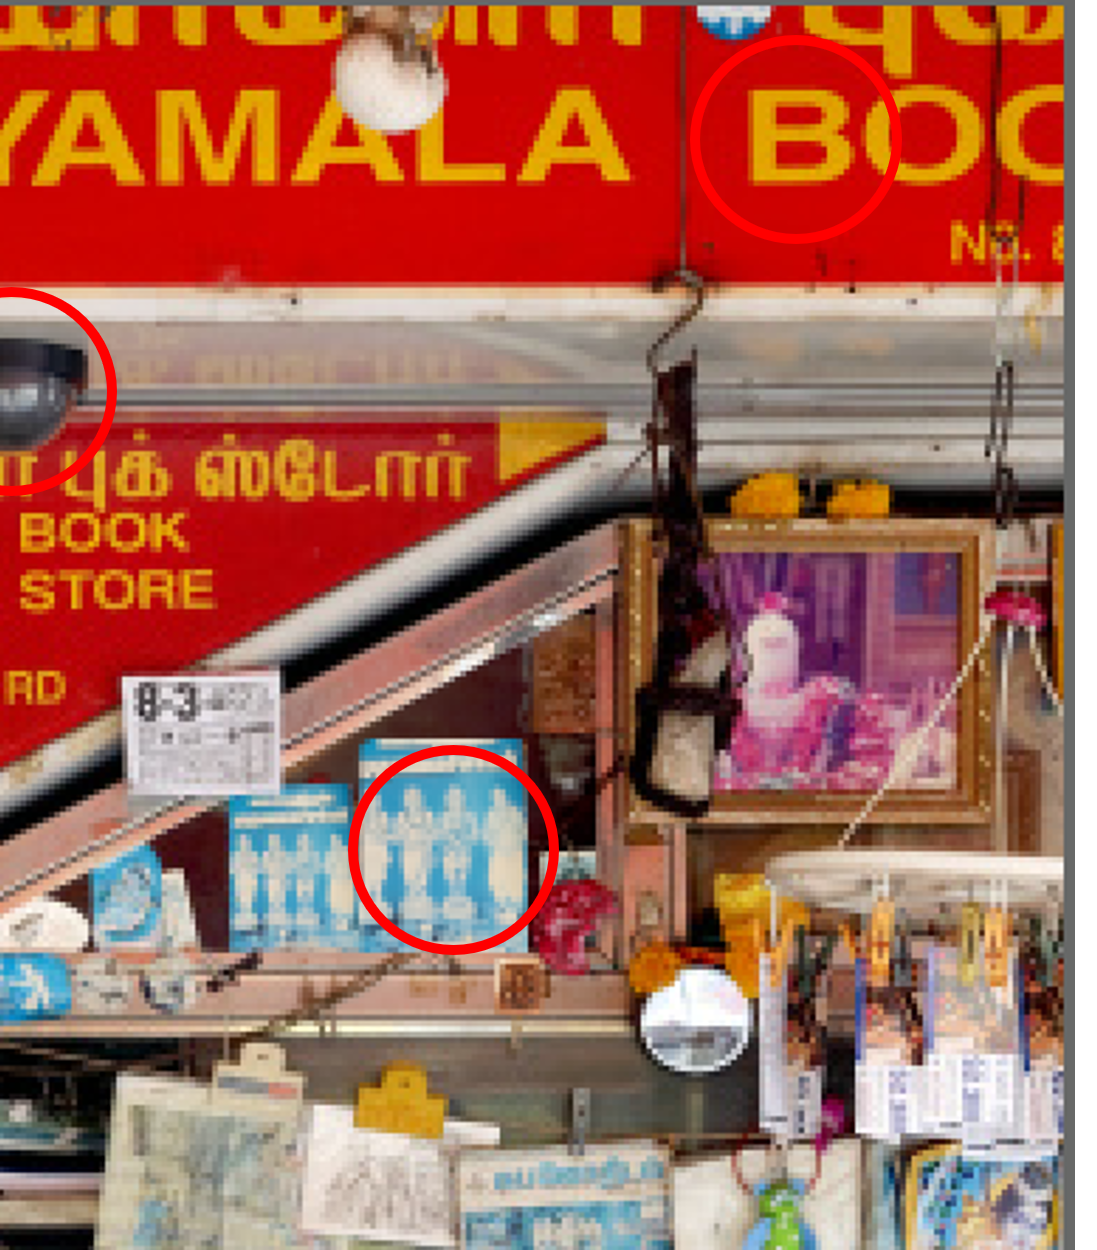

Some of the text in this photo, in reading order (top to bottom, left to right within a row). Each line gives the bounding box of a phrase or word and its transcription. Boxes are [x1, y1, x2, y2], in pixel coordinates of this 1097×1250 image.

[18, 510, 191, 554] BOOK
[18, 568, 220, 614] STORE
[3, 669, 68, 706] RD
